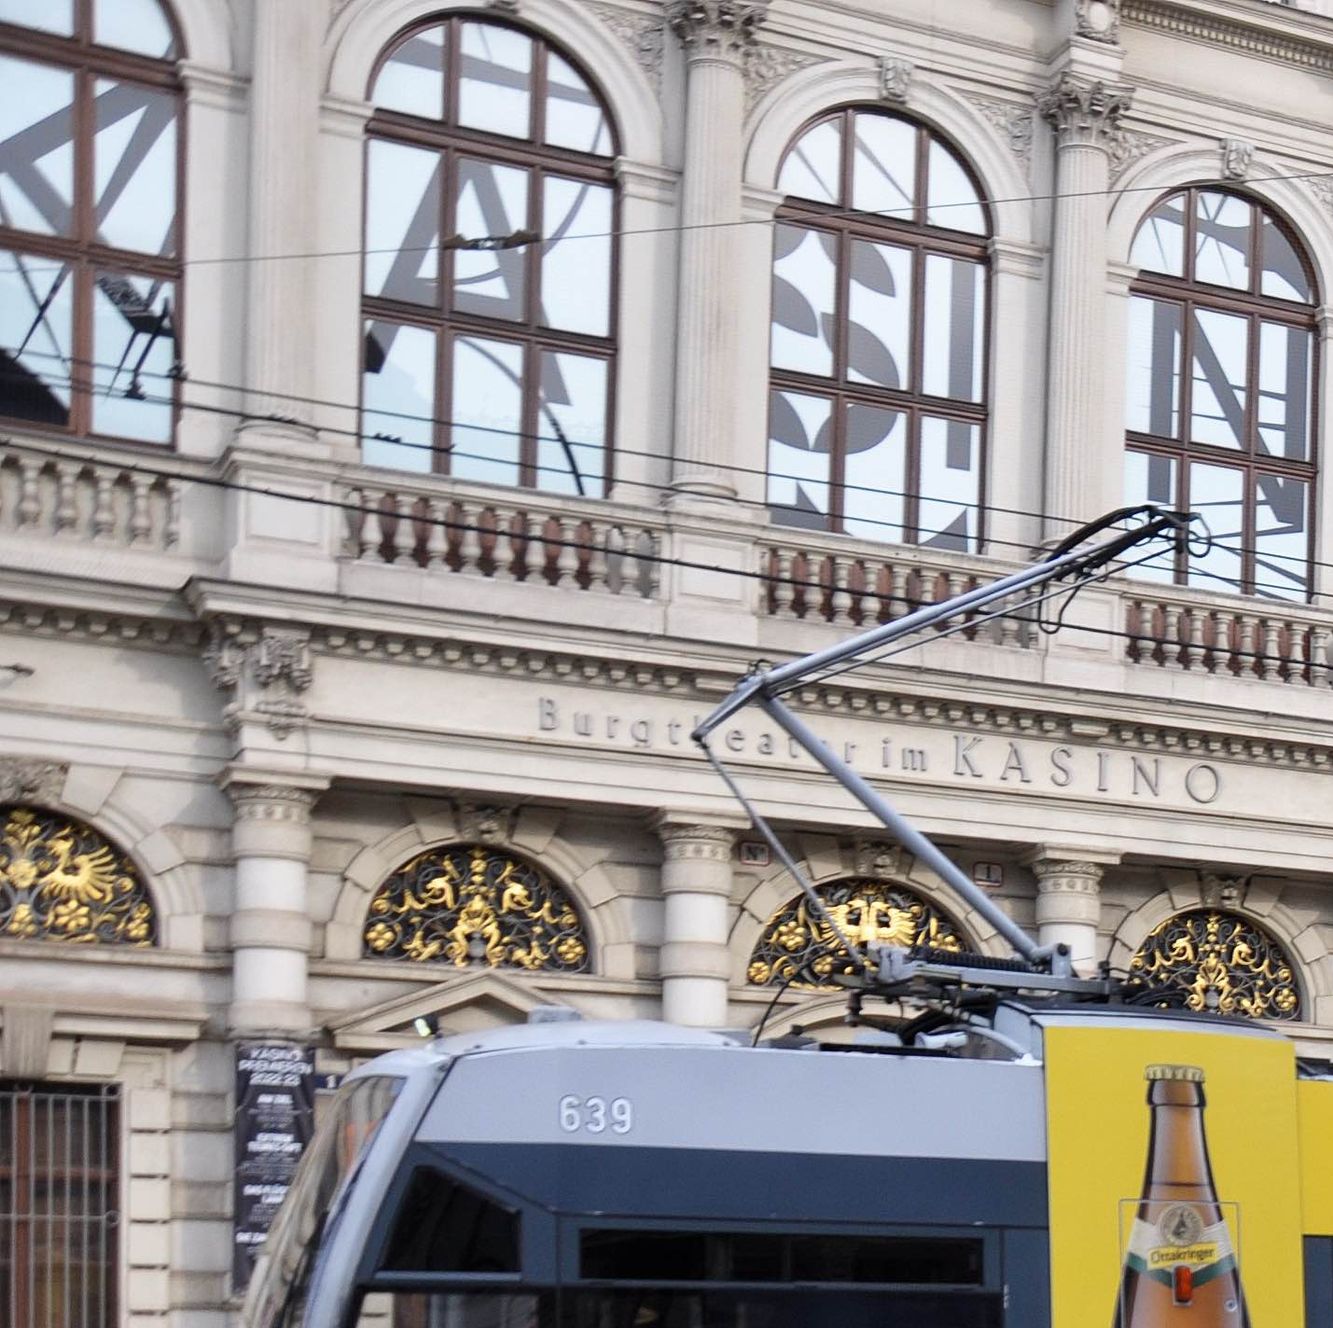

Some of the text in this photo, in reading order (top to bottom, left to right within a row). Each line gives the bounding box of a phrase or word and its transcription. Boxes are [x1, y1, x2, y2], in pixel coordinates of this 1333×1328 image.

[538, 696, 1222, 804] Burgteatr im KASINO
[558, 1095, 634, 1135] 639
[1150, 1247, 1215, 1263] Ottakringer
